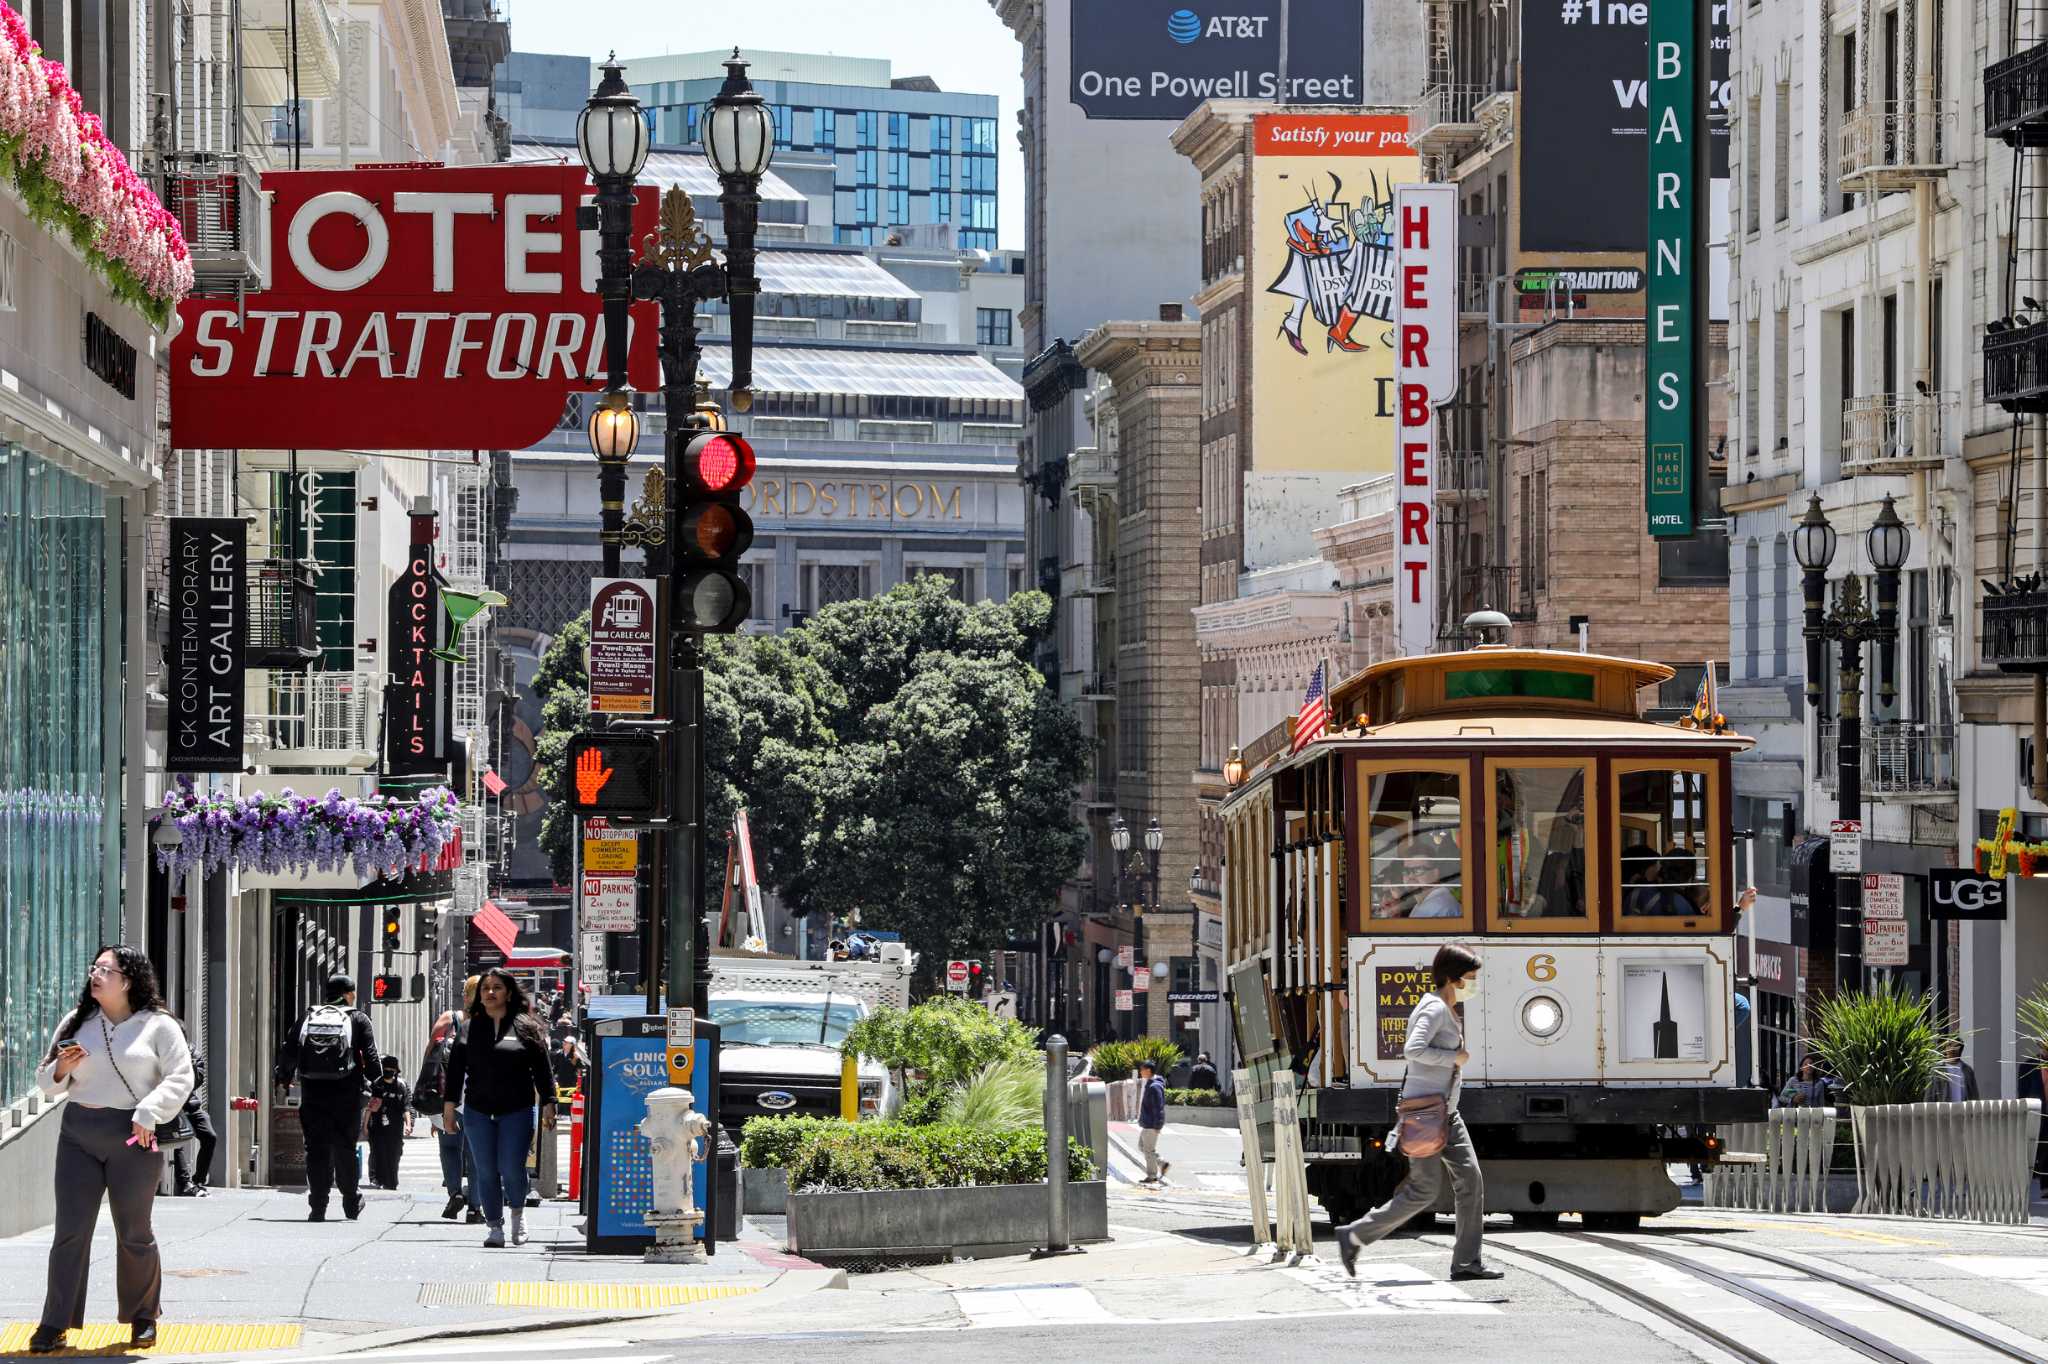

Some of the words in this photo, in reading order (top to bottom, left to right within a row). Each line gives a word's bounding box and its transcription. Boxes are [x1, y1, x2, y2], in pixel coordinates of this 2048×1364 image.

[1561, 0, 1600, 25] #1
[1205, 16, 1269, 38] AT&T
[1079, 70, 1141, 97] One
[1151, 70, 1249, 98] Powell
[1271, 126, 1330, 148] Satisfy
[1333, 130, 1375, 148] your
[1655, 41, 1682, 410] BARNES
[1558, 271, 1639, 289] TRADITION
[189, 310, 636, 380] STRATFORD
[1401, 205, 1430, 604] HERBERT
[1657, 452, 1679, 461] THE
[1651, 514, 1684, 525] HOTEL
[210, 532, 234, 675] GALLERY
[181, 531, 200, 713] CONTEMPORARY
[610, 631, 633, 639] CABLE
[634, 631, 650, 640] CAR
[410, 559, 427, 754] COCKTAILS
[208, 685, 232, 748] ART
[180, 719, 197, 748] CK
[586, 827, 601, 839] NO
[600, 829, 634, 840] STOPPING
[585, 880, 600, 895] NO
[602, 883, 634, 895] PARKING
[1865, 875, 1878, 889] NO
[1934, 878, 2002, 911] UGG
[1865, 921, 1877, 934] NO
[1879, 924, 1906, 934] PARKING
[1381, 972, 1433, 984] POWE
[1526, 953, 1558, 982] 6
